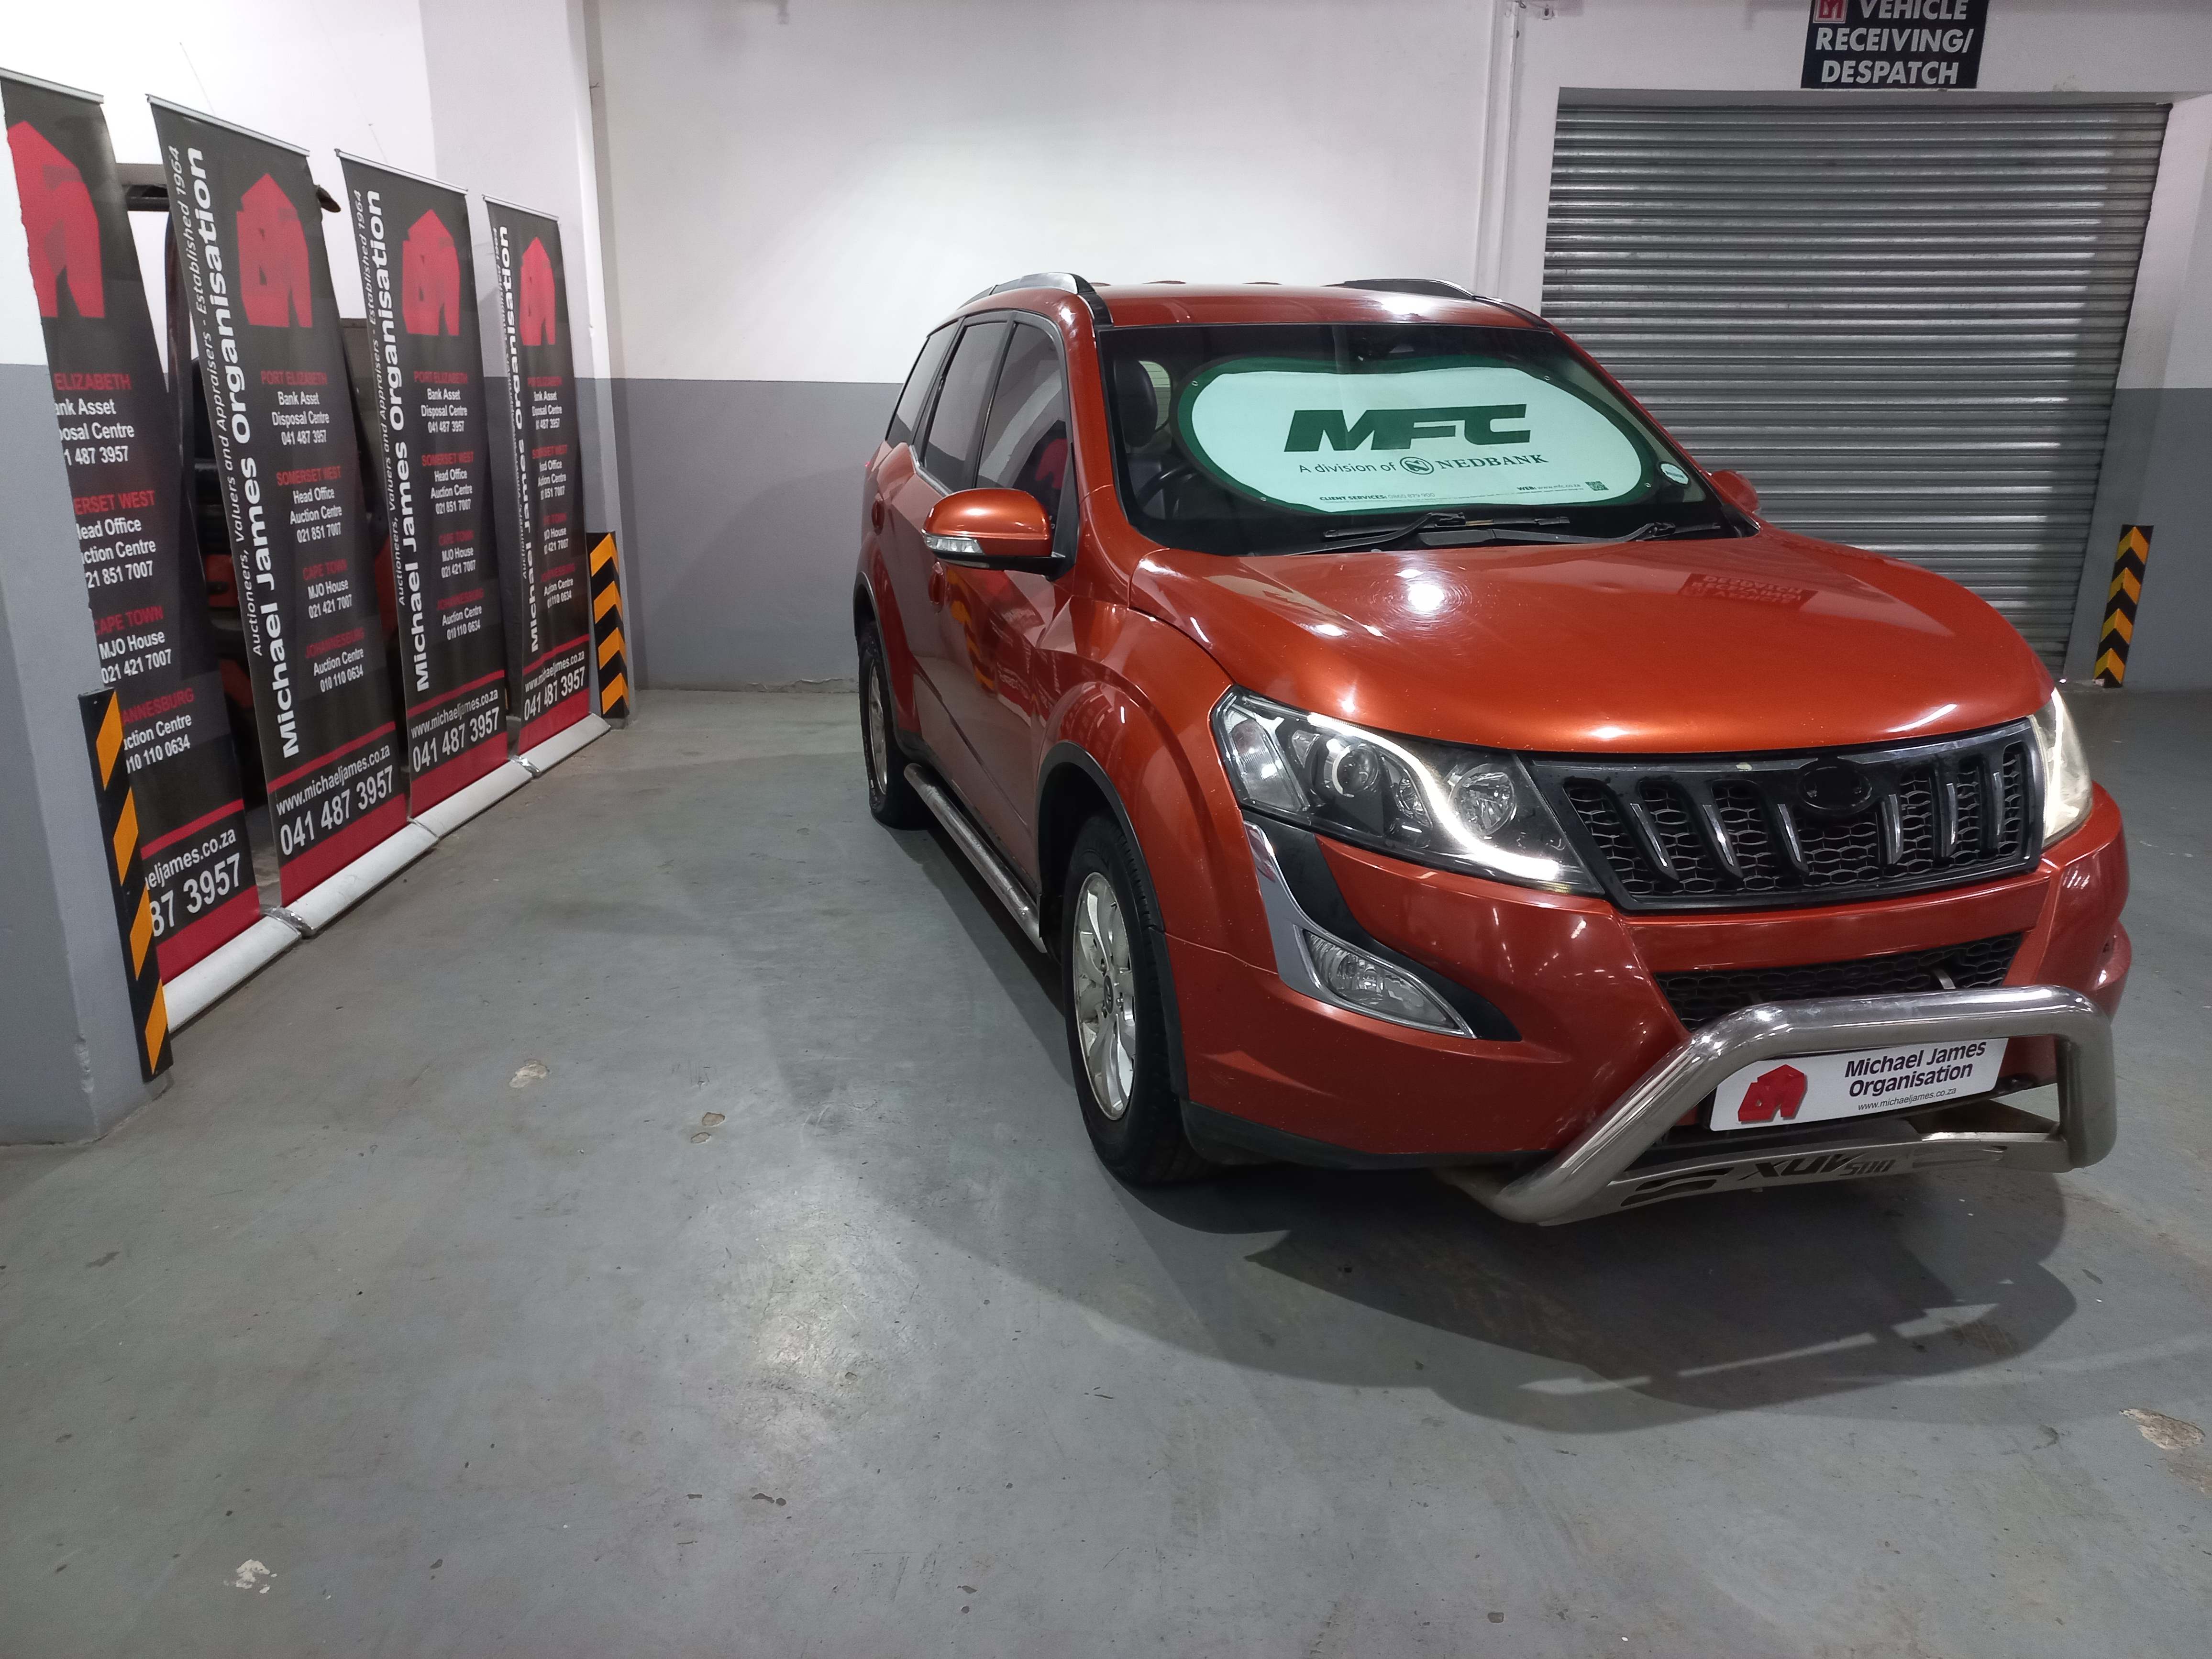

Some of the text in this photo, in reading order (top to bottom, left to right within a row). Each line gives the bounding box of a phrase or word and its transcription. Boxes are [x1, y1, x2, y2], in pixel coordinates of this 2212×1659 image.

[1861, 0, 1968, 20] VEHICLE
[1815, 27, 1974, 53] RECEIVING/
[1821, 60, 1958, 84] DESPATCH
[168, 145, 186, 195] 1964
[177, 200, 207, 314] Established
[203, 331, 227, 431] Appraisers
[78, 398, 117, 415] Asset
[277, 391, 320, 405] Bank Asset
[421, 405, 448, 419] Disposal
[59, 422, 134, 441] osal Centre
[272, 410, 330, 428] Disposal Centre
[1284, 404, 1531, 452] MFC
[281, 430, 327, 445] 041 487 3957
[367, 190, 429, 692] Michael James Organisation
[75, 447, 96, 465] 487
[99, 445, 128, 463] 3957
[188, 148, 299, 758] Michael James Organisation
[218, 435, 233, 471] and
[1299, 454, 1549, 474] A division of NEDBANK
[74, 490, 155, 515] ERSET WEST
[227, 476, 244, 542] Valuers
[293, 487, 335, 504] Head Office
[76, 517, 142, 540] ead Office
[290, 505, 342, 525] Auction Centre
[297, 528, 310, 543] 021
[311, 525, 325, 540] 851
[80, 539, 156, 564] ction Centre
[85, 560, 153, 588] 21 851 7007
[240, 549, 263, 656] Auctioneers,
[308, 579, 348, 599] MJO House
[526, 542, 539, 653] Michael
[125, 606, 164, 627] TOWN
[309, 603, 321, 619] 021
[322, 599, 335, 614] 421
[99, 631, 165, 660] MJO House
[101, 649, 172, 684] 021 421 7007
[314, 648, 364, 676] Auction Centre
[320, 664, 364, 692] 010 110 0634
[121, 687, 195, 726] ANNESBURG
[524, 666, 585, 721] 041 487 3957
[411, 689, 498, 739] www.michaeljames.co.za
[123, 714, 192, 751] ction Centre
[413, 706, 499, 773] 041 487 3957
[126, 734, 190, 774] 10 110 0634
[276, 745, 390, 816] www.michaeljames.co.za
[280, 765, 393, 855] 041 487 3957
[145, 829, 236, 891] eljames.co.za
[150, 852, 240, 937] 87 3957
[1845, 1041, 1987, 1078] Michael James
[1849, 1063, 1973, 1097] Organisation
[1858, 1087, 1957, 1111] www.michaeljames.co.za
